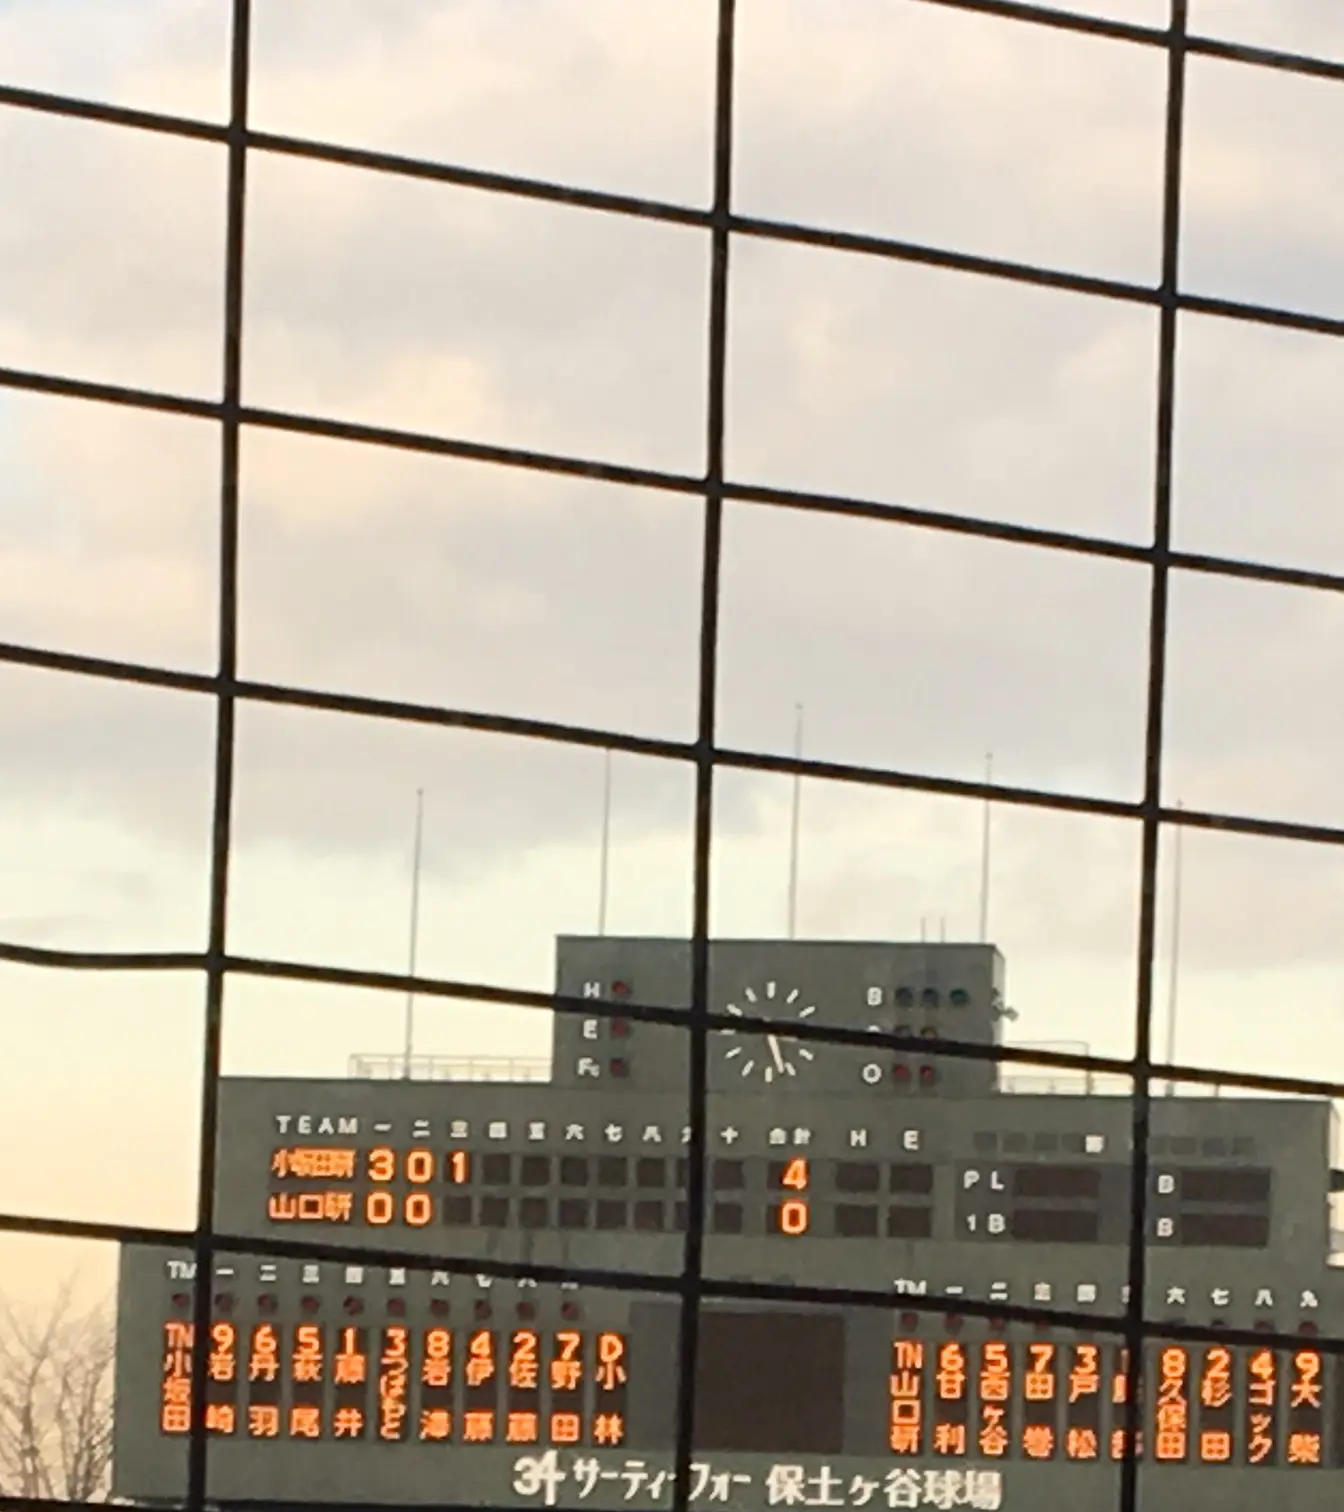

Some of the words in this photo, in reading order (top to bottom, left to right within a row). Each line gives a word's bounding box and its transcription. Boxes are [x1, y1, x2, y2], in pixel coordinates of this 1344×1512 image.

[584, 983, 600, 998] H
[868, 988, 882, 1006] B
[584, 1020, 598, 1038] E
[276, 1115, 358, 1134] TEAM
[782, 1159, 807, 1189] 4
[269, 1192, 353, 1221] 山口研
